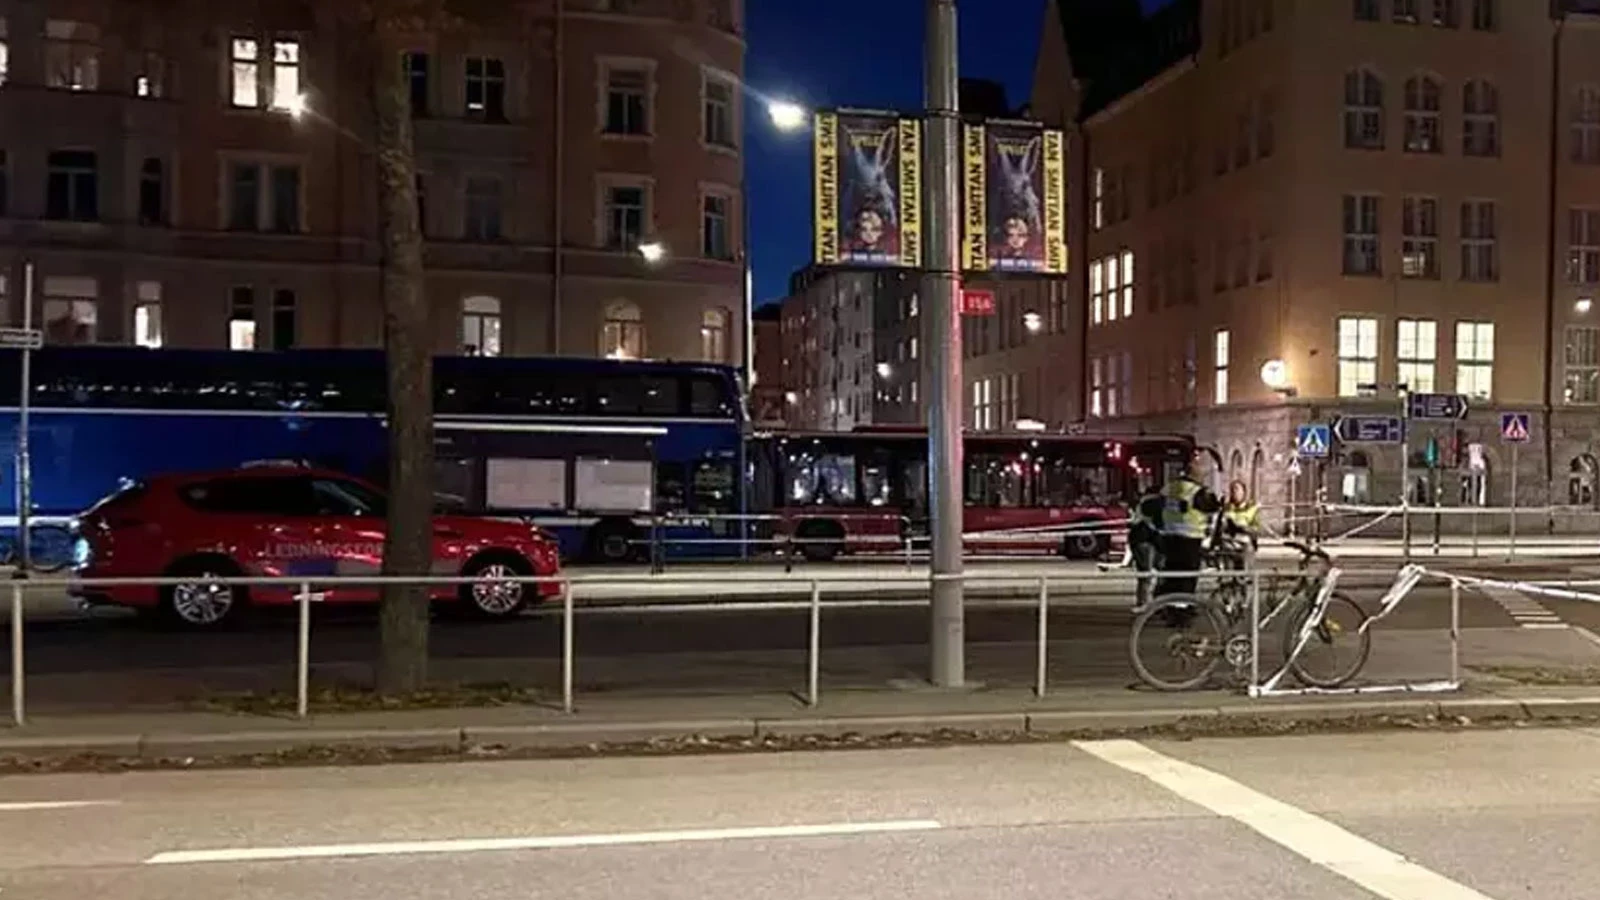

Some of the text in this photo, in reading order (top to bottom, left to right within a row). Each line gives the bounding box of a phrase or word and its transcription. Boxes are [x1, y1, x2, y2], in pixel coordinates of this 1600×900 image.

[821, 155, 834, 219] SMITTAN
[902, 160, 916, 223] SMITTAN
[969, 164, 982, 227] SMITTAN
[1047, 168, 1060, 231] SMITTAN
